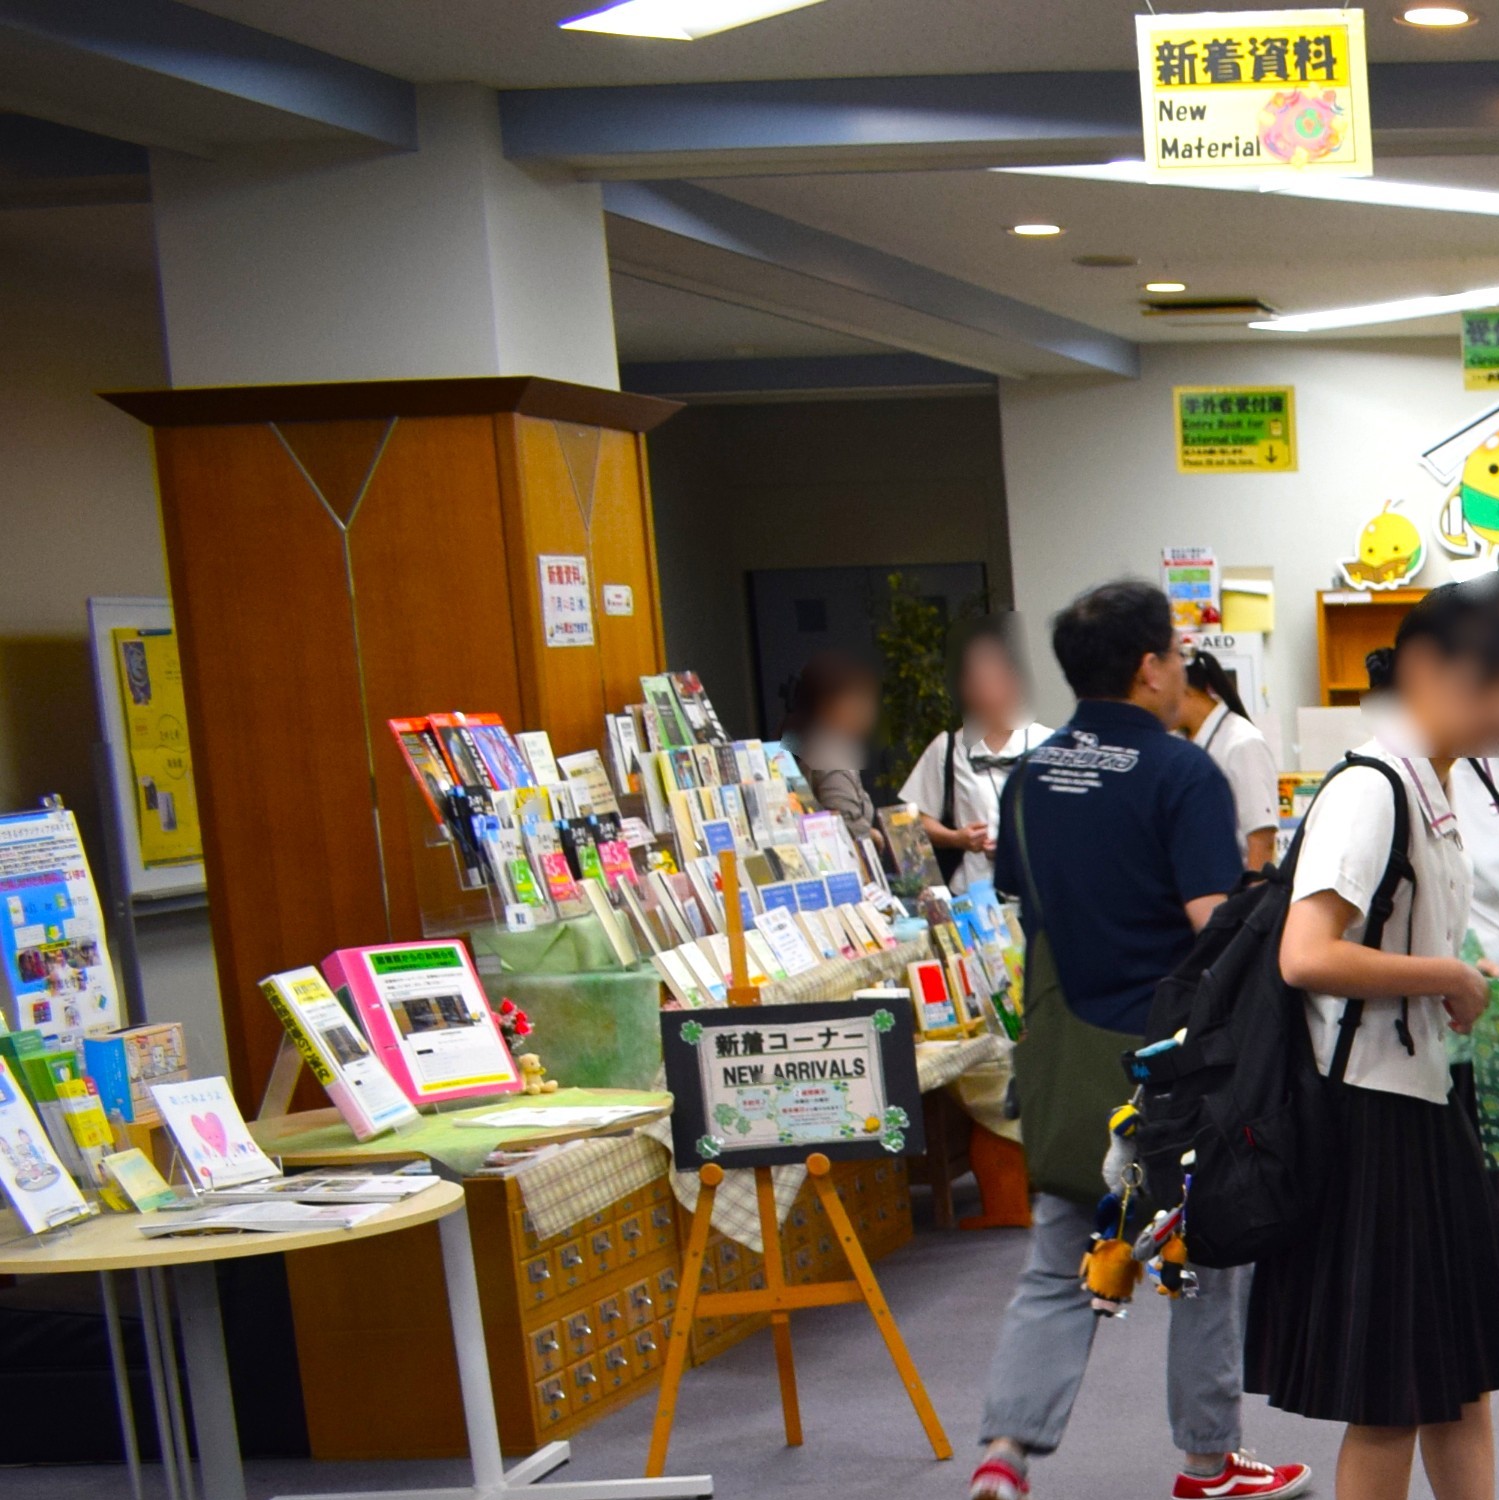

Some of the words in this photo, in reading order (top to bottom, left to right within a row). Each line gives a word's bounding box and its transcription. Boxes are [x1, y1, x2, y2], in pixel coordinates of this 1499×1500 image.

[1155, 35, 1336, 86] 新着資料
[1159, 100, 1207, 122] New
[1161, 134, 1261, 159] Material
[1201, 635, 1235, 649] AED
[715, 1027, 864, 1057] 新着コーナー
[723, 1064, 764, 1085] NEW
[773, 1057, 866, 1081] ARRIVALS
